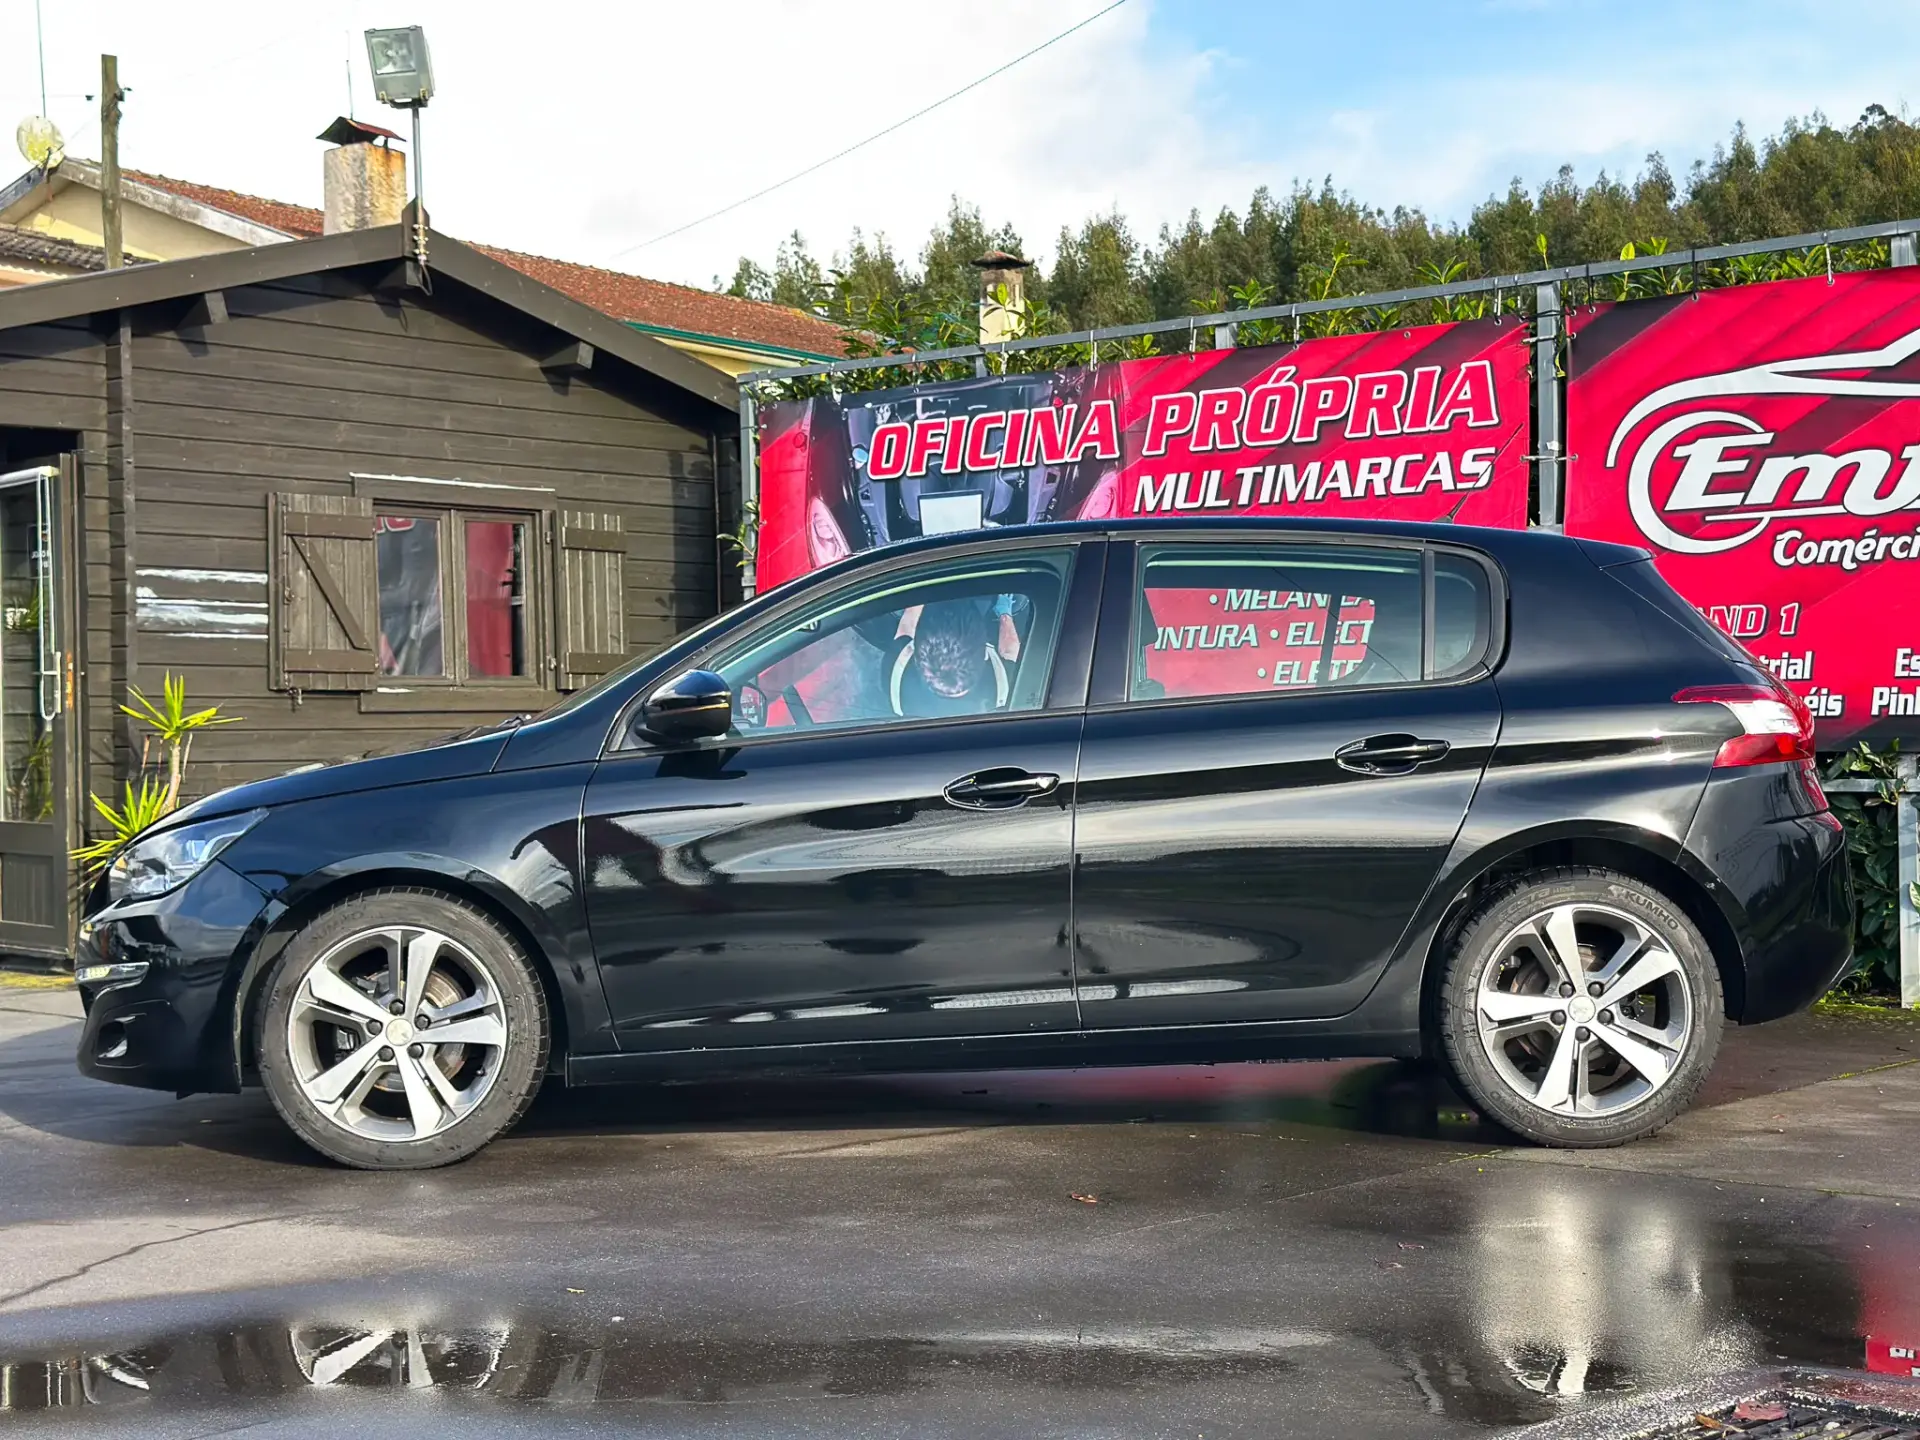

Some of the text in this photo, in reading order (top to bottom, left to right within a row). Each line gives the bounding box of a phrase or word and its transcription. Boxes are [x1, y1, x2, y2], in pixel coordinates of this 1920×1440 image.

[866, 360, 1499, 480] OFICINA PRÓPRIA
[1133, 445, 1496, 514] MULTIMARCAS
[1697, 602, 1799, 636] ND 1
[1759, 651, 1812, 680] rial
[1801, 687, 1843, 717] éis
[1624, 890, 1682, 931] KUMHO
